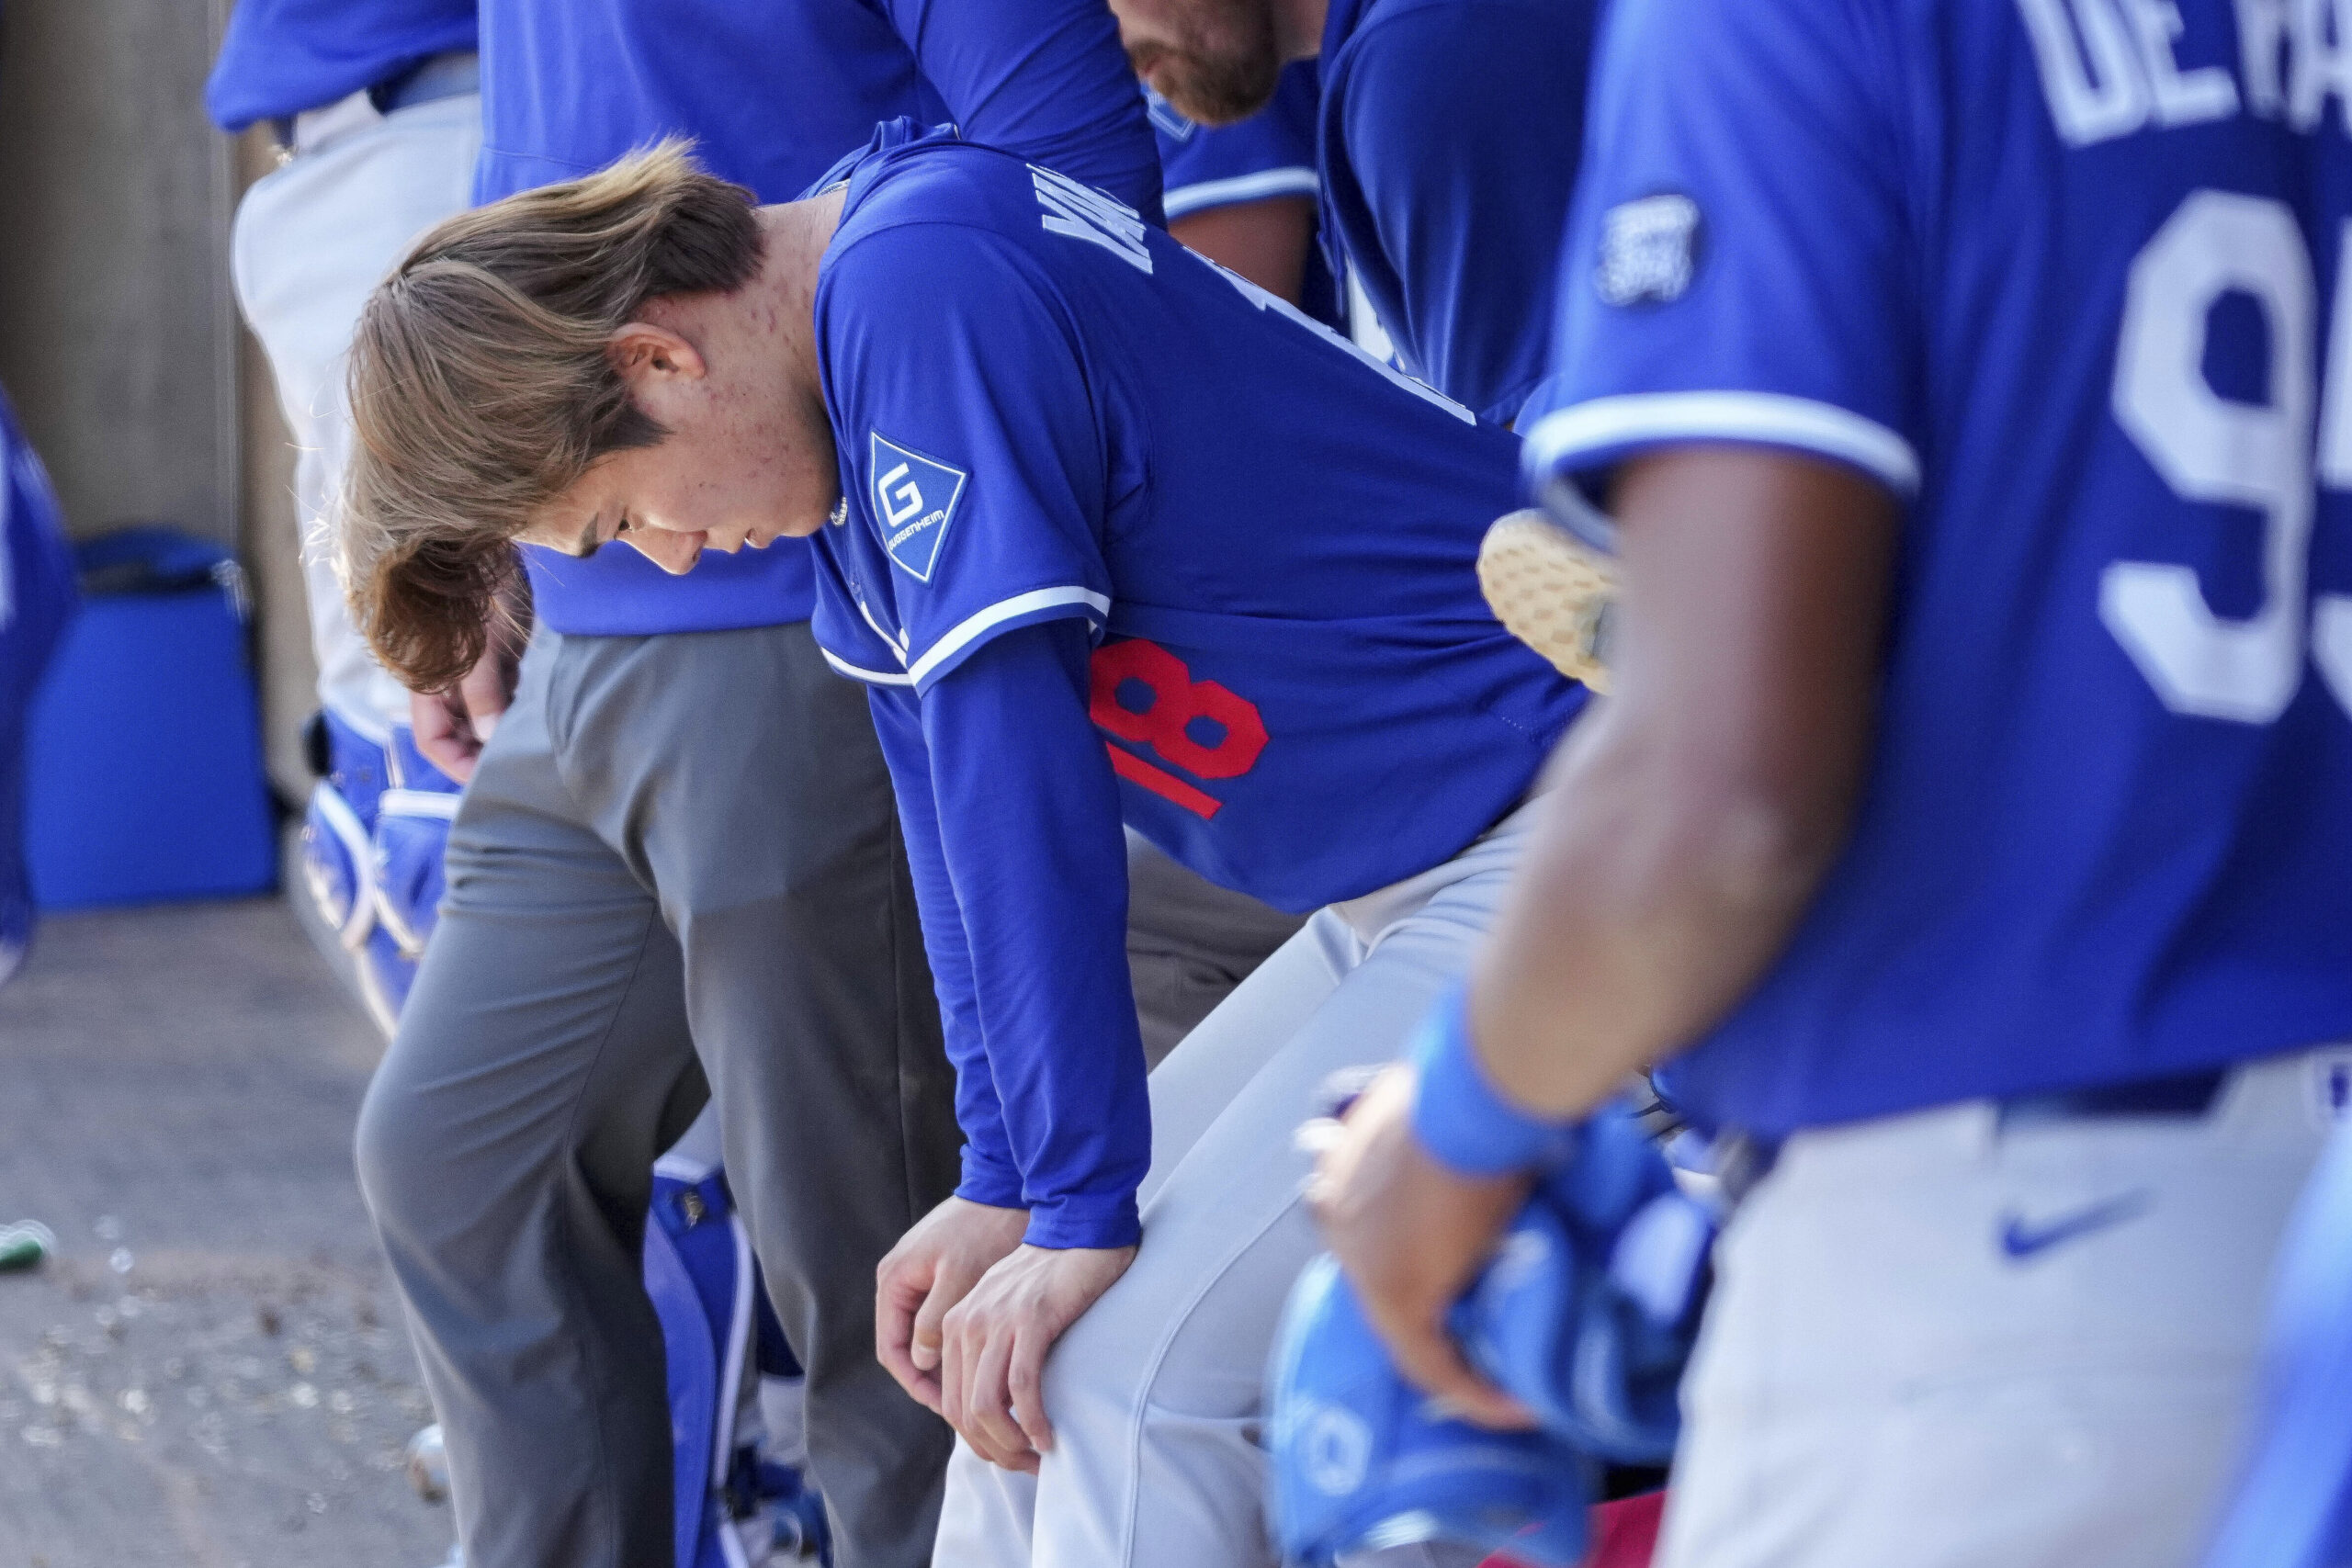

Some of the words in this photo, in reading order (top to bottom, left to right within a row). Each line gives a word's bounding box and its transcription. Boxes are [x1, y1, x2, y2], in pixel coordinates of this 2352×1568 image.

[878, 462, 923, 528] G
[2098, 189, 2352, 725] 9
[1090, 638, 1270, 820] 18
